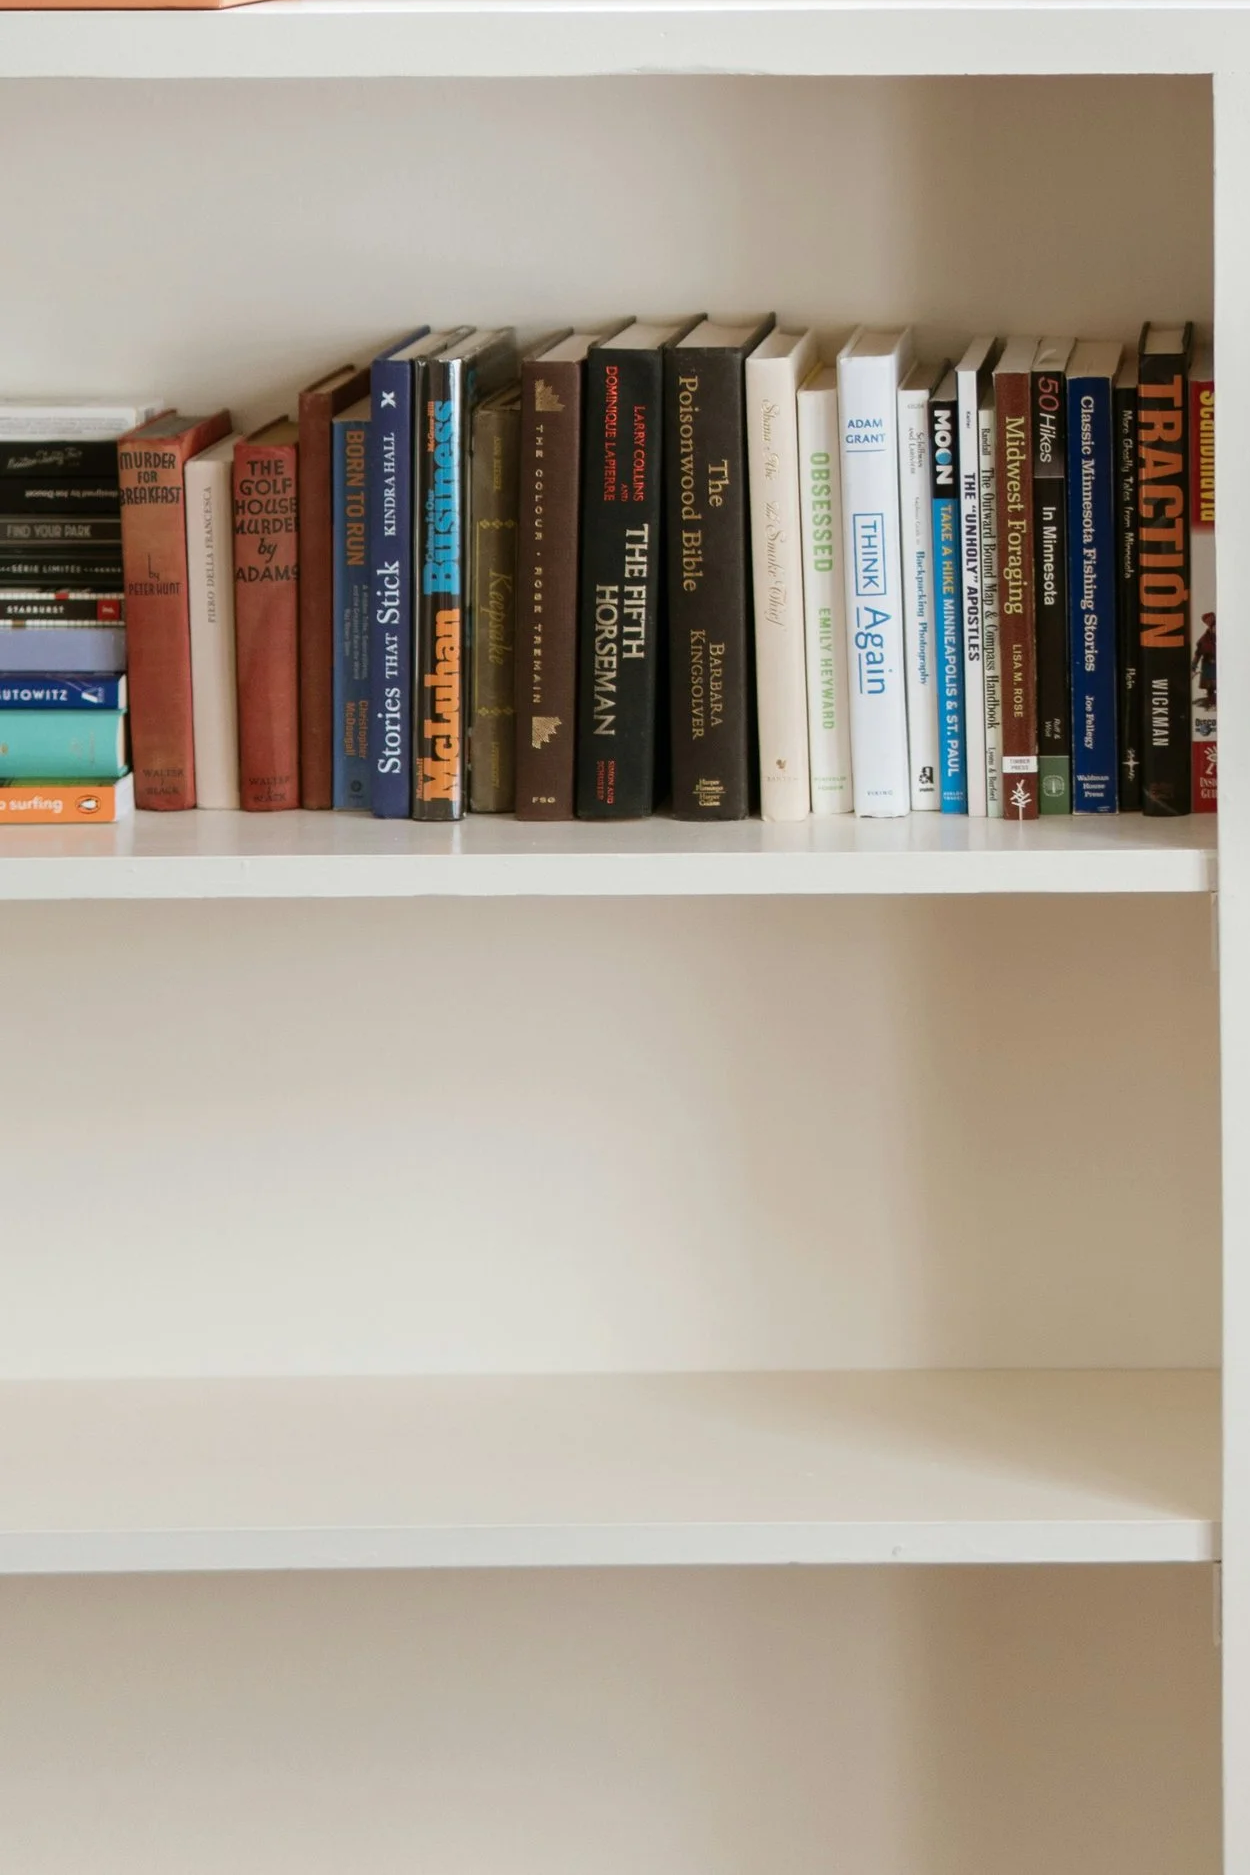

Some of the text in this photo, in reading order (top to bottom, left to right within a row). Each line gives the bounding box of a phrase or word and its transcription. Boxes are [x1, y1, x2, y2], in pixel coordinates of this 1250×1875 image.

[603, 366, 618, 501] DOMINIQUE LAPIERRE
[633, 406, 646, 502] LARRY COLLINS
[845, 433, 885, 444] GRANT
[847, 419, 883, 429] ADAM
[934, 409, 954, 485] MOON
[119, 451, 176, 470] MURDER
[137, 471, 158, 484] FOR
[239, 477, 293, 496] GOLF
[246, 459, 285, 476] THE
[679, 376, 704, 591] Poisonwood Bible
[708, 459, 729, 507] The
[1037, 376, 1059, 606] 50 Hikes In Minnesota
[119, 486, 182, 506] BREAKFAST
[234, 498, 298, 515] HOUSE
[345, 430, 365, 566] BORN TO RUN
[423, 400, 460, 595] Business
[940, 504, 954, 542] TAKE
[7, 524, 91, 538] FIND YOUR PARK
[203, 486, 216, 623] PIERO DELLA FRANCESCA
[257, 538, 278, 564] by
[533, 425, 544, 704] THE COLOUR ROSE TREMAIN
[942, 545, 954, 557] A
[1080, 395, 1098, 672] Classic Minnesota Fishing Stories
[1138, 375, 1188, 747] TRACTION WICKMAN
[622, 524, 649, 659] THE FIFTH
[809, 451, 835, 730] OBSESSED EMILY HEYWARD
[942, 560, 955, 595] HIKE
[1004, 415, 1027, 717] Midwest Foraging LISA M. ROSE
[7, 604, 65, 615] STARBURST
[376, 432, 402, 774] Stories THAT Stick KINDRA HALL
[481, 566, 513, 666] Keepsake
[854, 520, 893, 695] THINK Again
[594, 584, 618, 736] HORSEMAN
[942, 598, 956, 692] MINNEAPOLIS
[423, 608, 460, 802] McLuhan
[690, 628, 707, 740] KINGSOLVER
[709, 642, 726, 727] BARBARA
[945, 695, 957, 706] &
[344, 701, 357, 756] McDougall
[357, 699, 369, 760] Christopher
[946, 714, 958, 737] ST.
[1084, 695, 1096, 750] Joe Fellegy
[946, 740, 959, 777] PAUL
[10, 796, 63, 813] surfing
